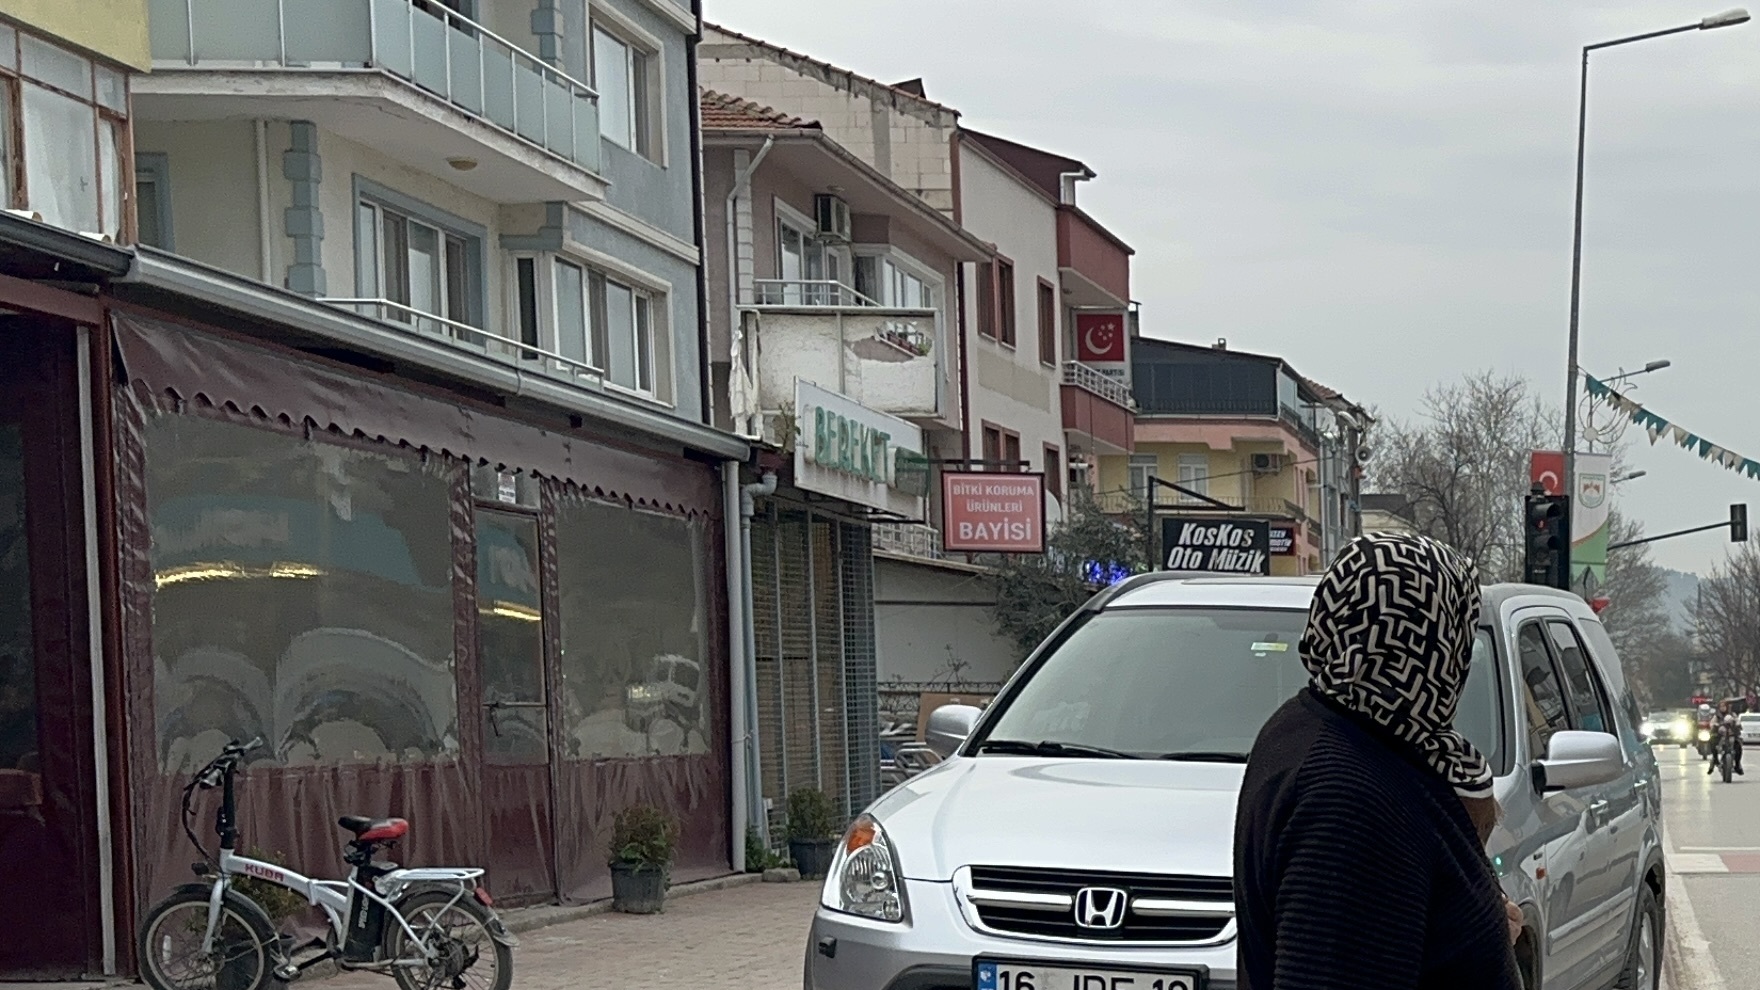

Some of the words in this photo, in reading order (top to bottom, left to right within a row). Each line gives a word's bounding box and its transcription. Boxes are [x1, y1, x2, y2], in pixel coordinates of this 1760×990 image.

[953, 482, 983, 496] BİTKİ
[985, 485, 1035, 496] KORUMA
[966, 501, 1023, 513] ÜRÜNLERİ
[959, 517, 1032, 541] BAYİSİ
[1177, 522, 1255, 548] KosKos
[1166, 546, 1203, 570] Oto
[1207, 548, 1266, 573] Müzik
[244, 863, 285, 882] KUDA
